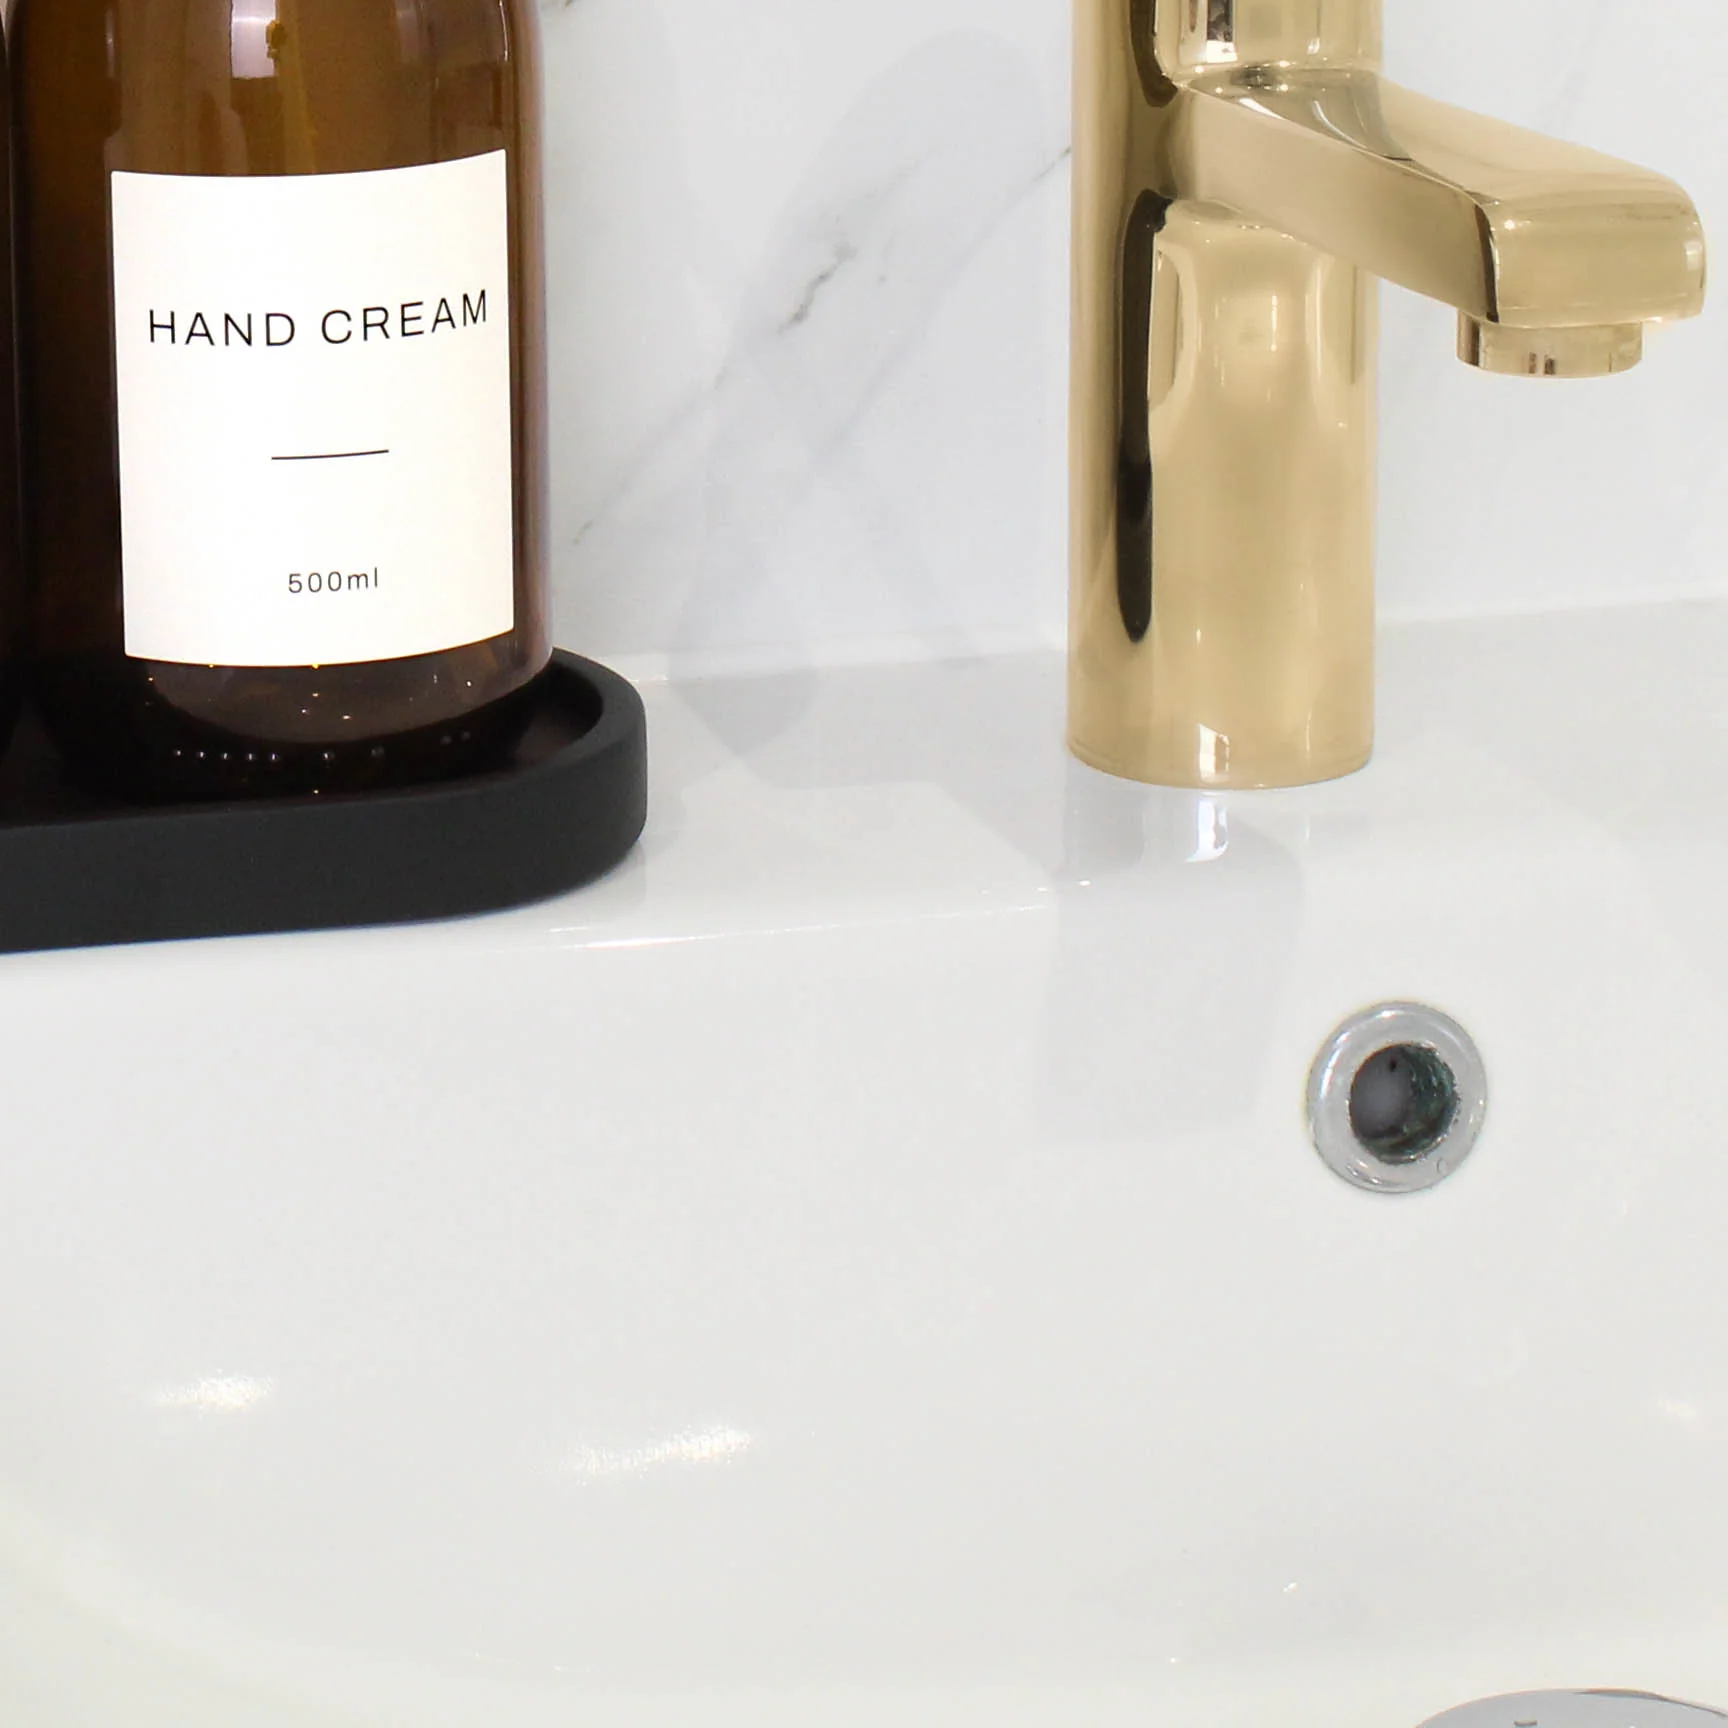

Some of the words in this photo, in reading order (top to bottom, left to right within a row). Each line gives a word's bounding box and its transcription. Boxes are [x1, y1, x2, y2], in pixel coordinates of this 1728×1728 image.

[149, 308, 296, 348] HAND
[321, 289, 487, 345] CREAM
[288, 566, 379, 595] 500ml
